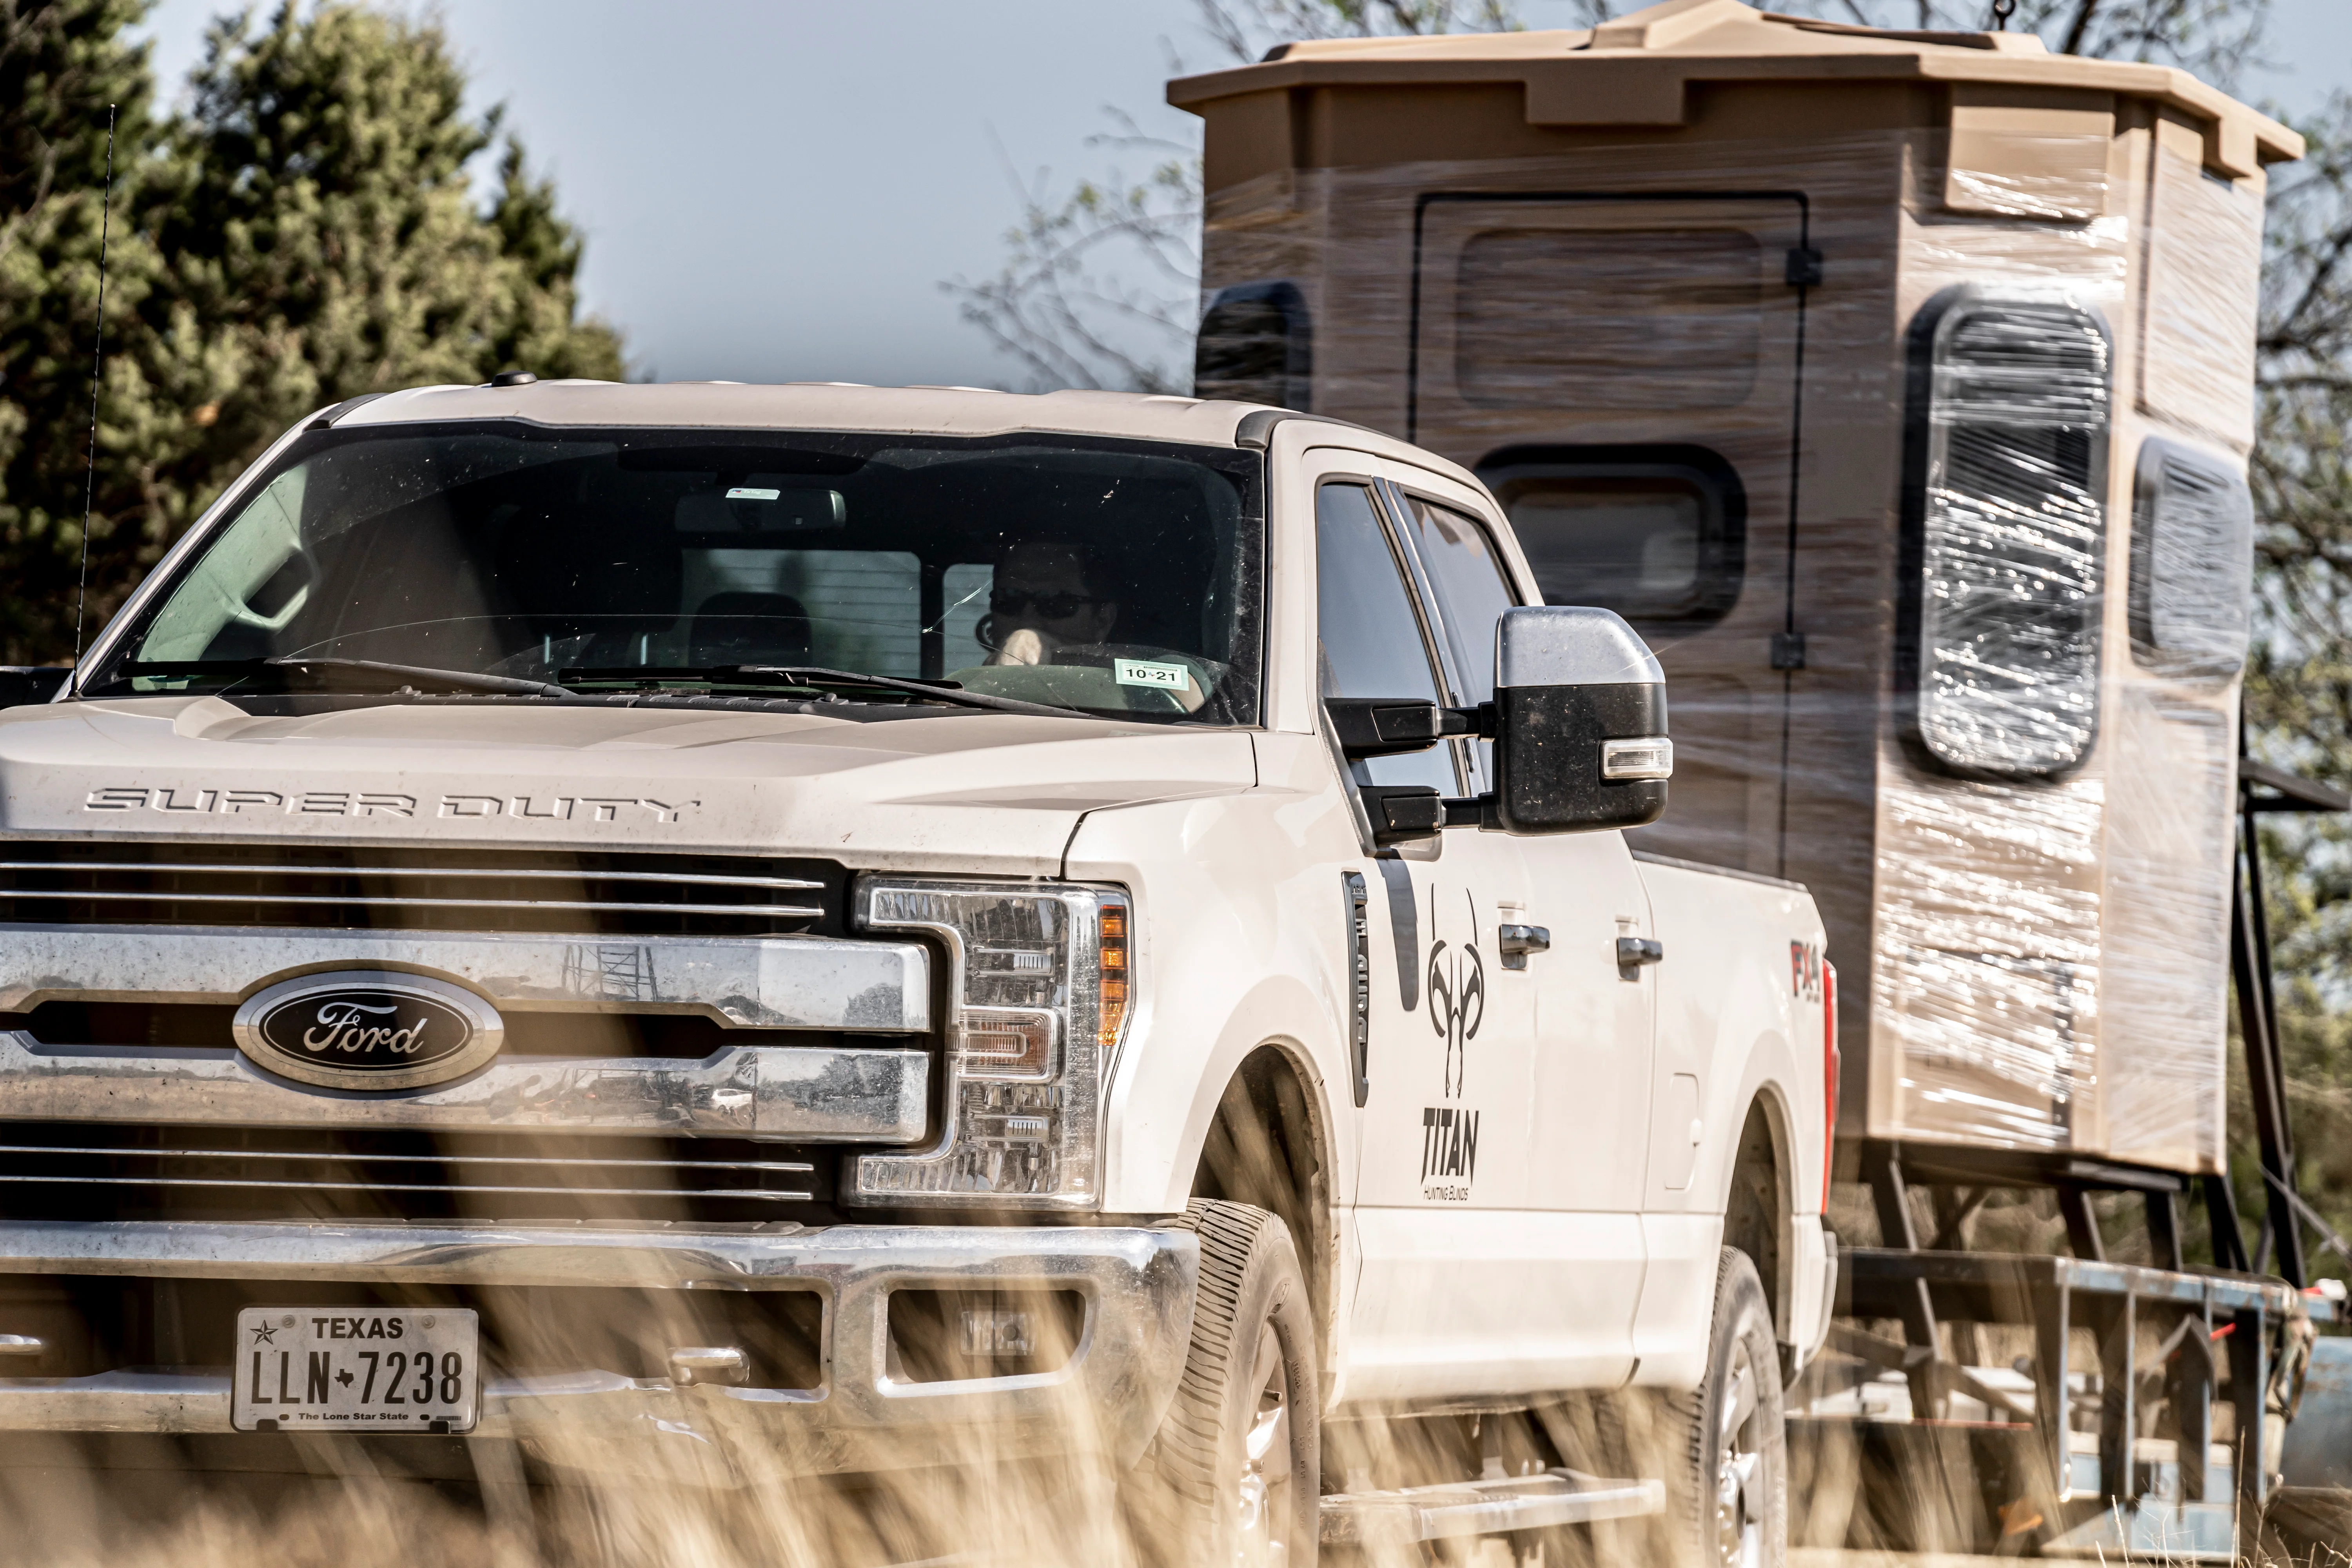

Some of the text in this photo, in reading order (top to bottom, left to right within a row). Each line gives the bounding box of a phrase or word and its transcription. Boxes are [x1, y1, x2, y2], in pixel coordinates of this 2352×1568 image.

[1126, 669, 1175, 681] 10 21
[83, 787, 701, 823] SUPER DUTY
[1790, 939, 1819, 997] FX4
[303, 1002, 428, 1053] Ford
[1420, 1107, 1479, 1187] TITAN
[1423, 1185, 1469, 1201] HUNTING BLINDS
[312, 1318, 403, 1339] TEXAS
